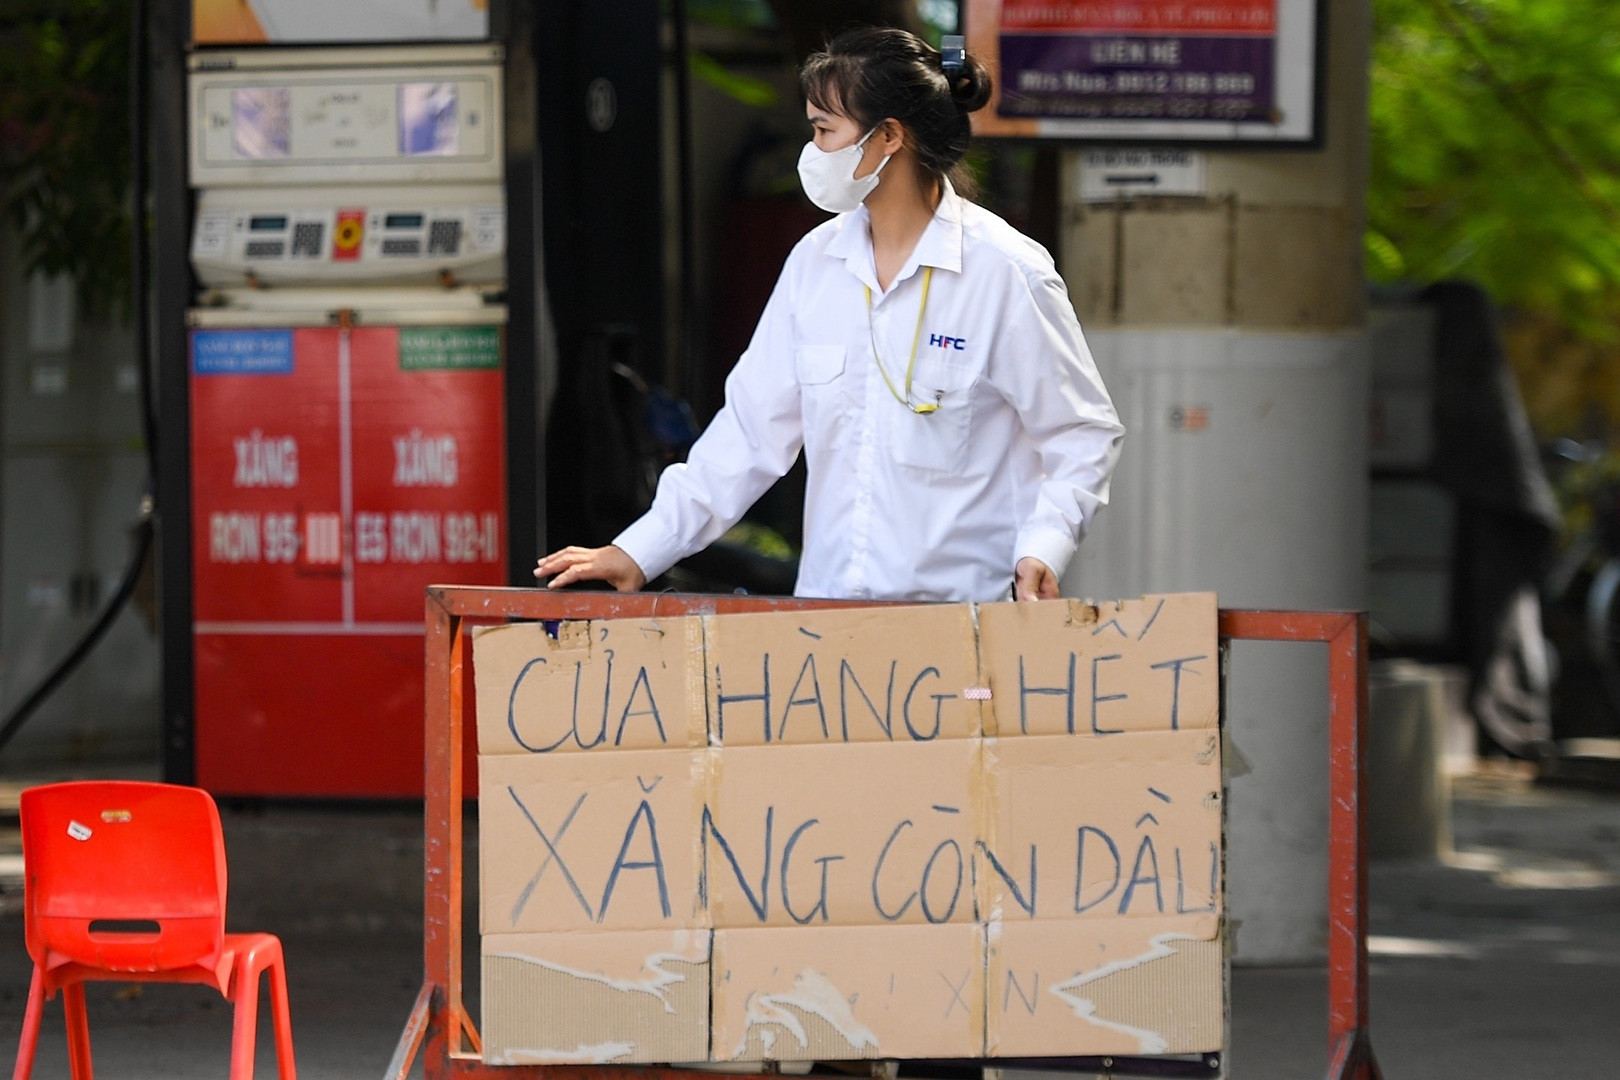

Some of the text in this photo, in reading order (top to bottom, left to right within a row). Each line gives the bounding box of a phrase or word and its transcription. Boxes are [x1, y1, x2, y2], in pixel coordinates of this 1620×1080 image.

[929, 333, 966, 350] HFC
[233, 427, 298, 487] XĂNG
[392, 427, 458, 487] XĂNG
[209, 511, 261, 563] RON
[355, 511, 387, 563] E5
[390, 511, 441, 563] RON
[508, 599, 1208, 753] CỬA HÀNG HẾT
[507, 775, 1220, 928] XĂNG CÒN DẦU
